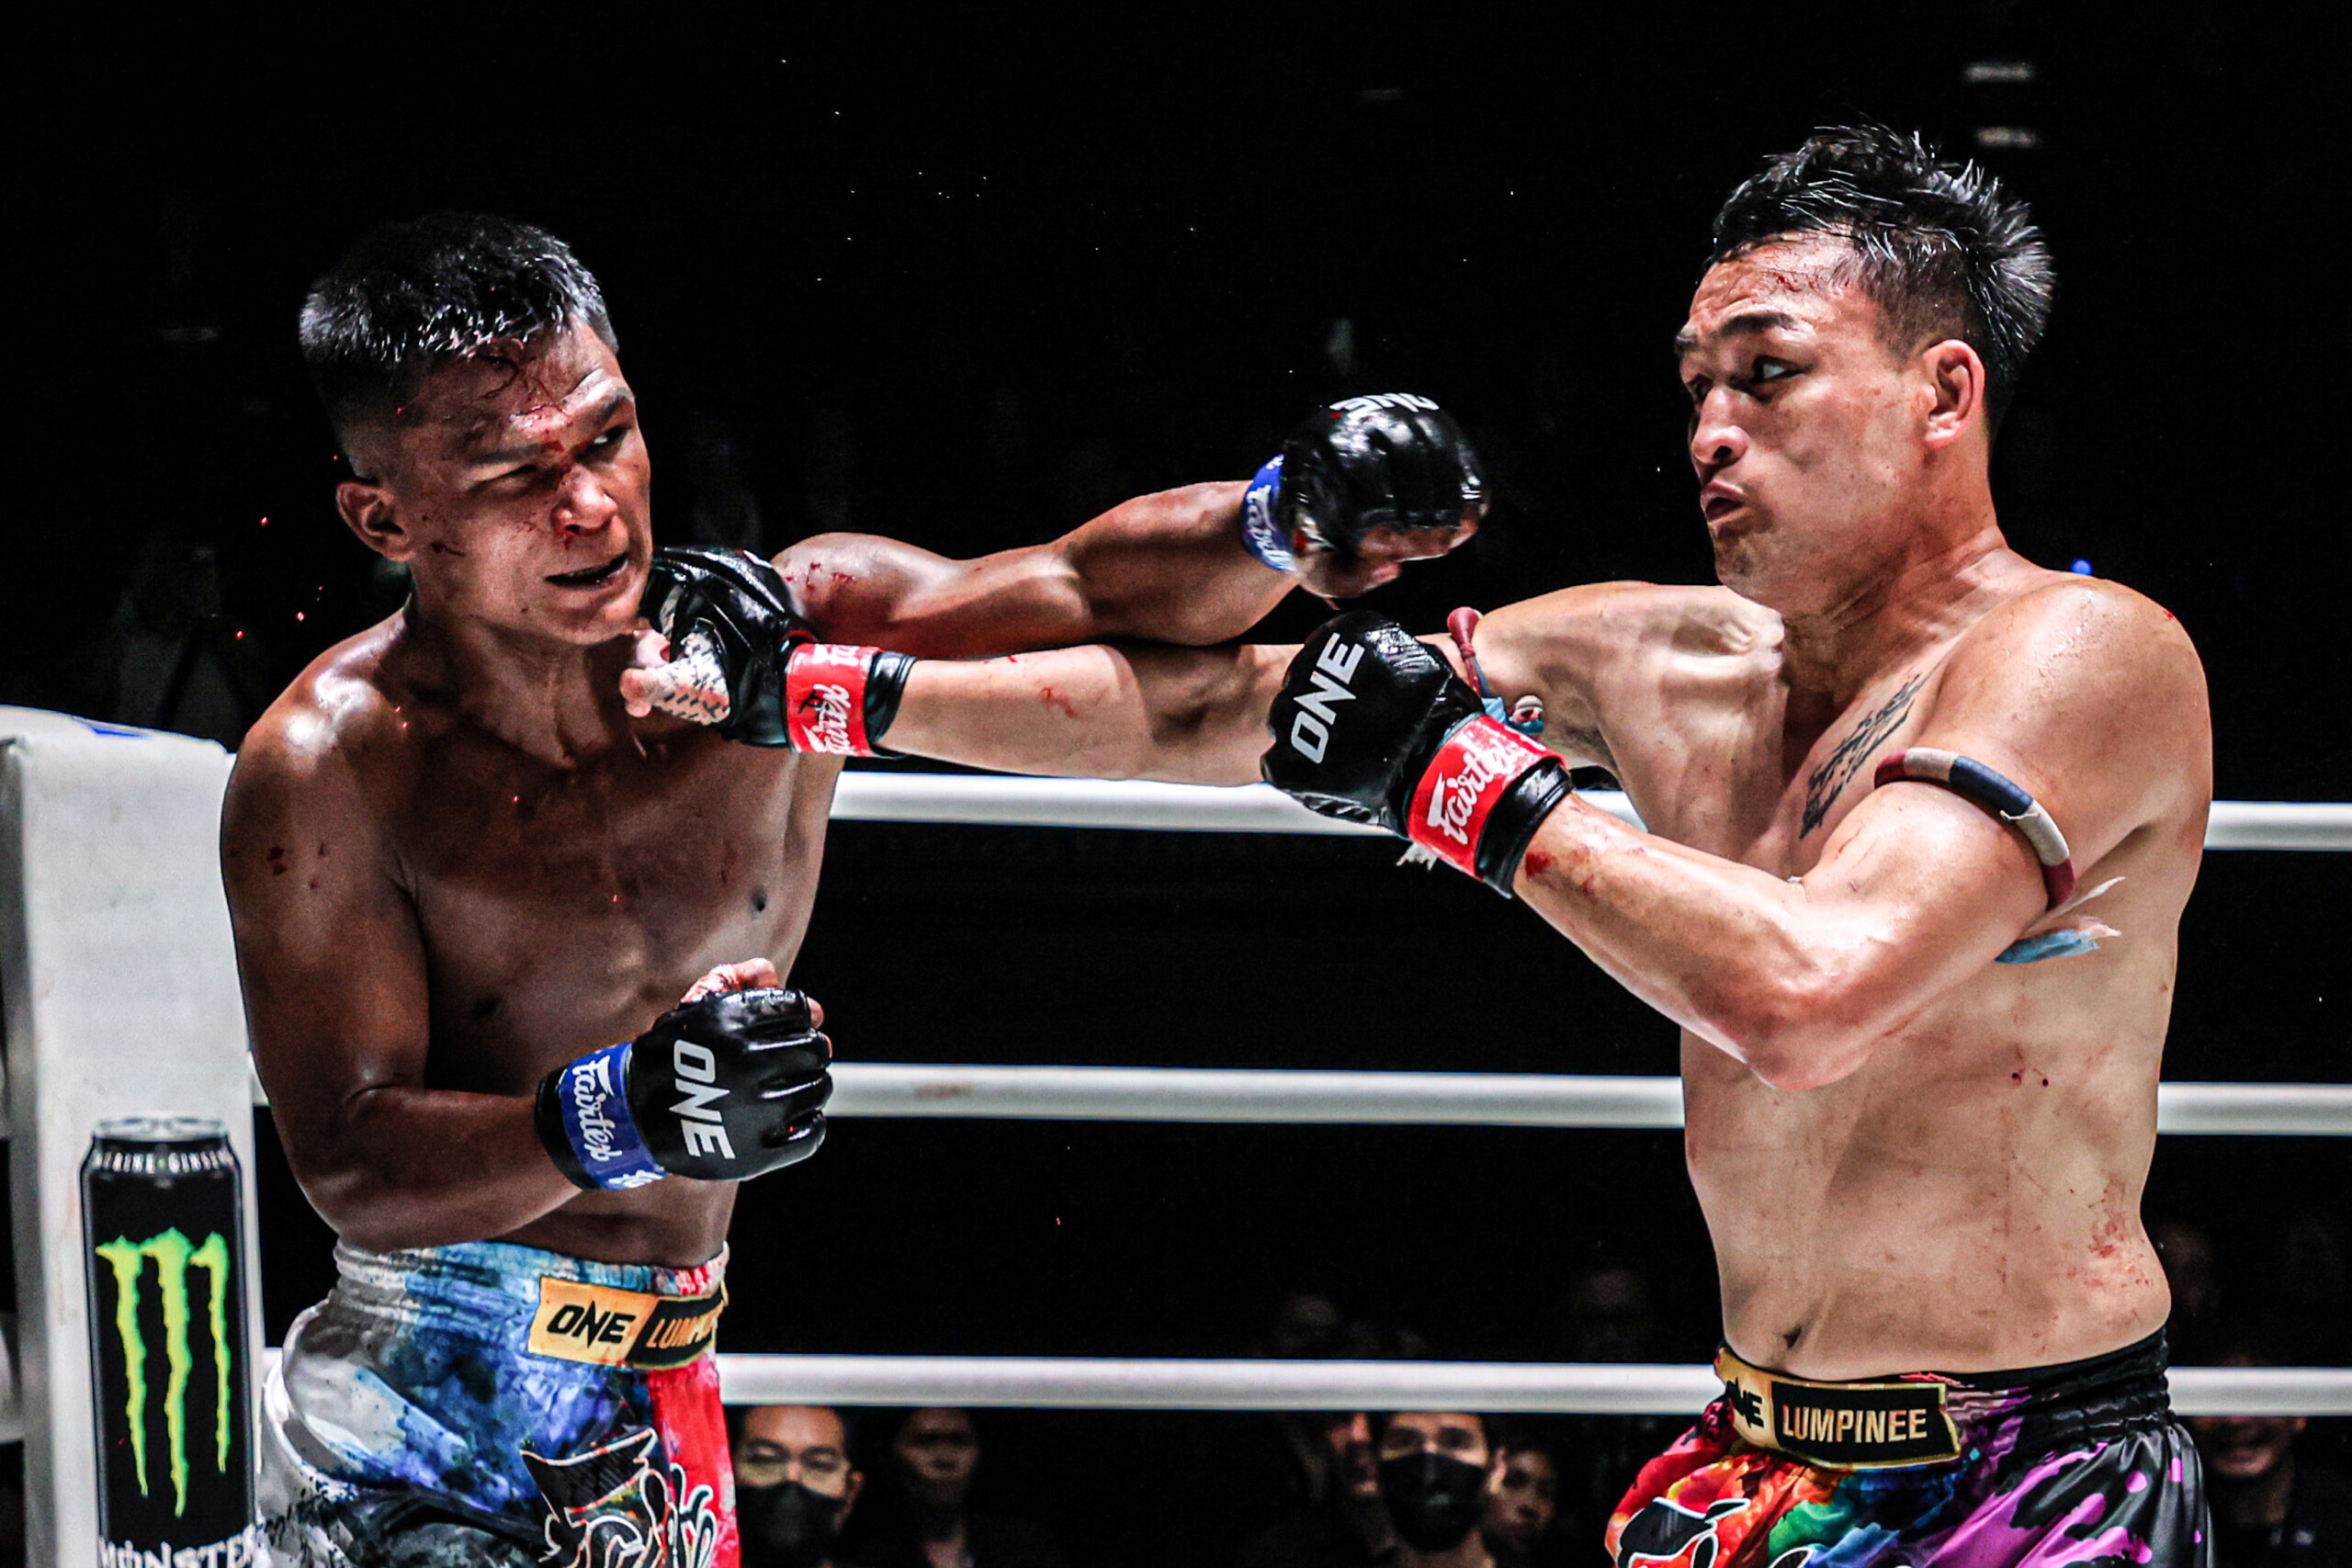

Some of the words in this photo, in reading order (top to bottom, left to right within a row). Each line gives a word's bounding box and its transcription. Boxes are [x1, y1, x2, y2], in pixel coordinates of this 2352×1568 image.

[1291, 632, 1365, 764] ONE
[571, 1055, 623, 1162] Fairtex
[669, 1039, 736, 1159] ONE
[547, 1301, 636, 1348] ONE
[1725, 1376, 1764, 1428] NE
[1782, 1404, 1928, 1443] LUMPINEE
